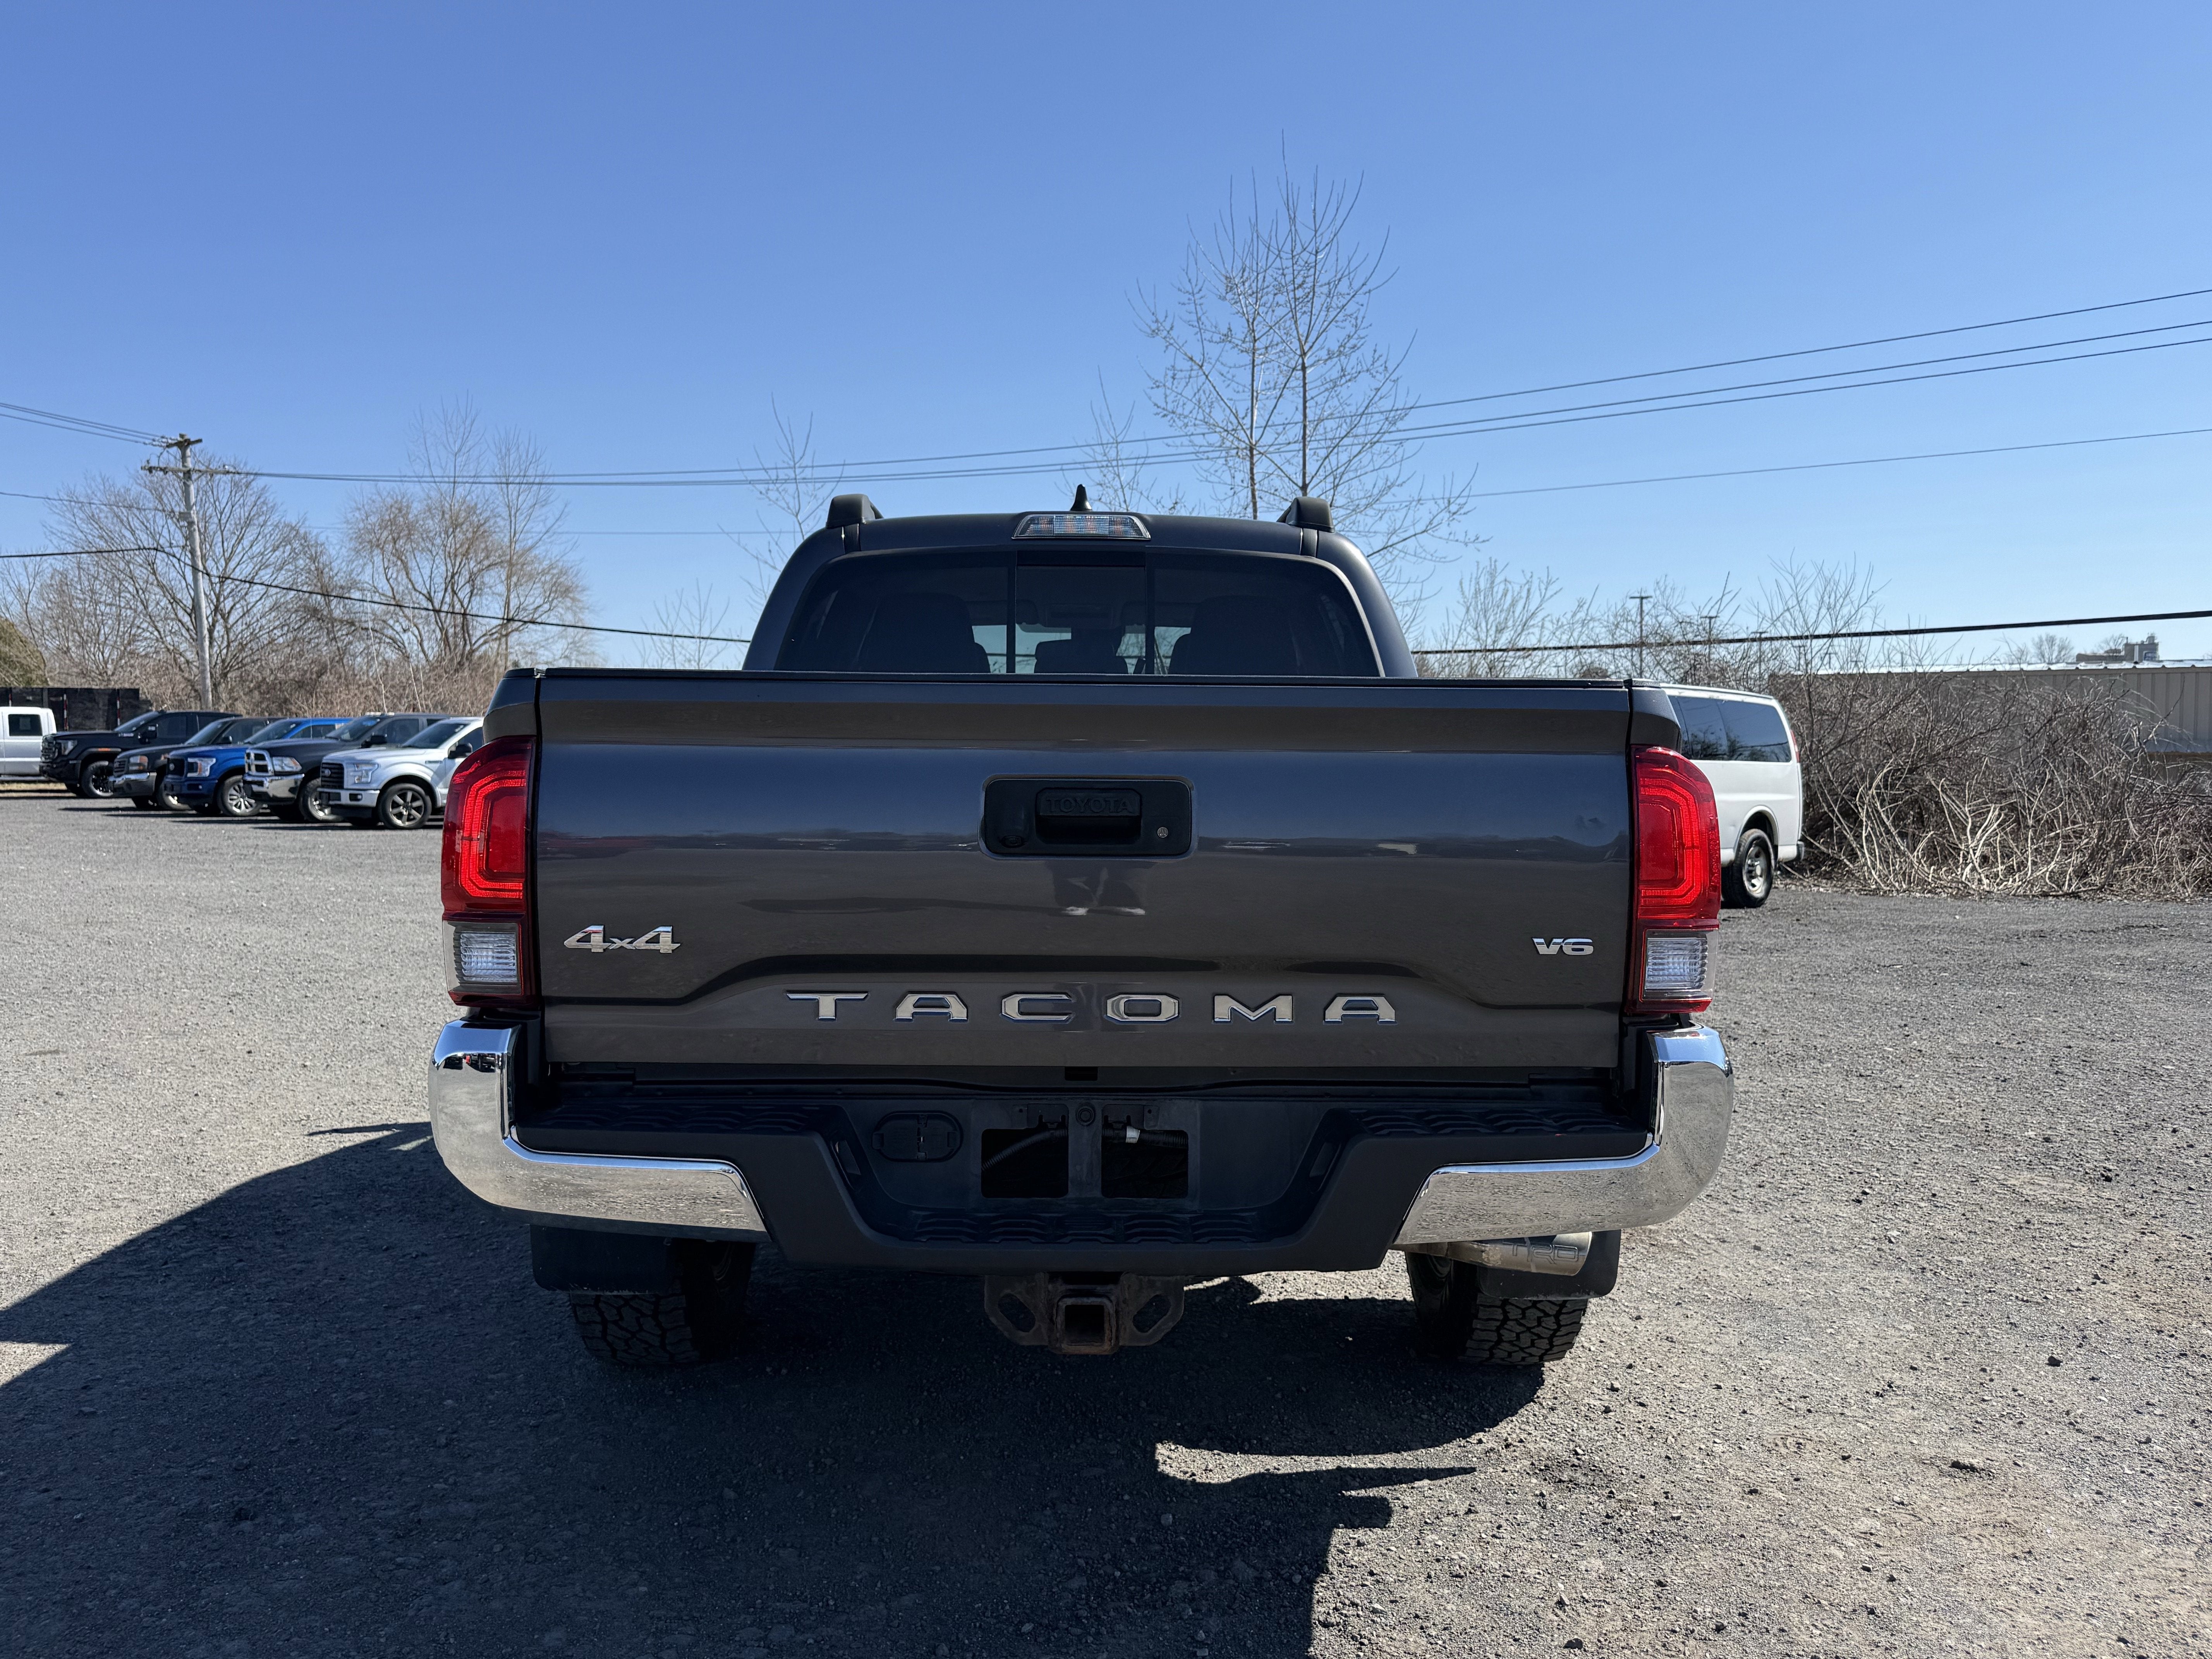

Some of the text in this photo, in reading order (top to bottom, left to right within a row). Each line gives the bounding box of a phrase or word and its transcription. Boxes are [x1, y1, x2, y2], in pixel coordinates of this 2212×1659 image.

[1046, 798, 1134, 813] TOYOTA
[564, 925, 680, 953] 4x4
[1532, 938, 1594, 955] V6
[786, 993, 1396, 1022] TACOMA
[1502, 1238, 1579, 1264] TRD
